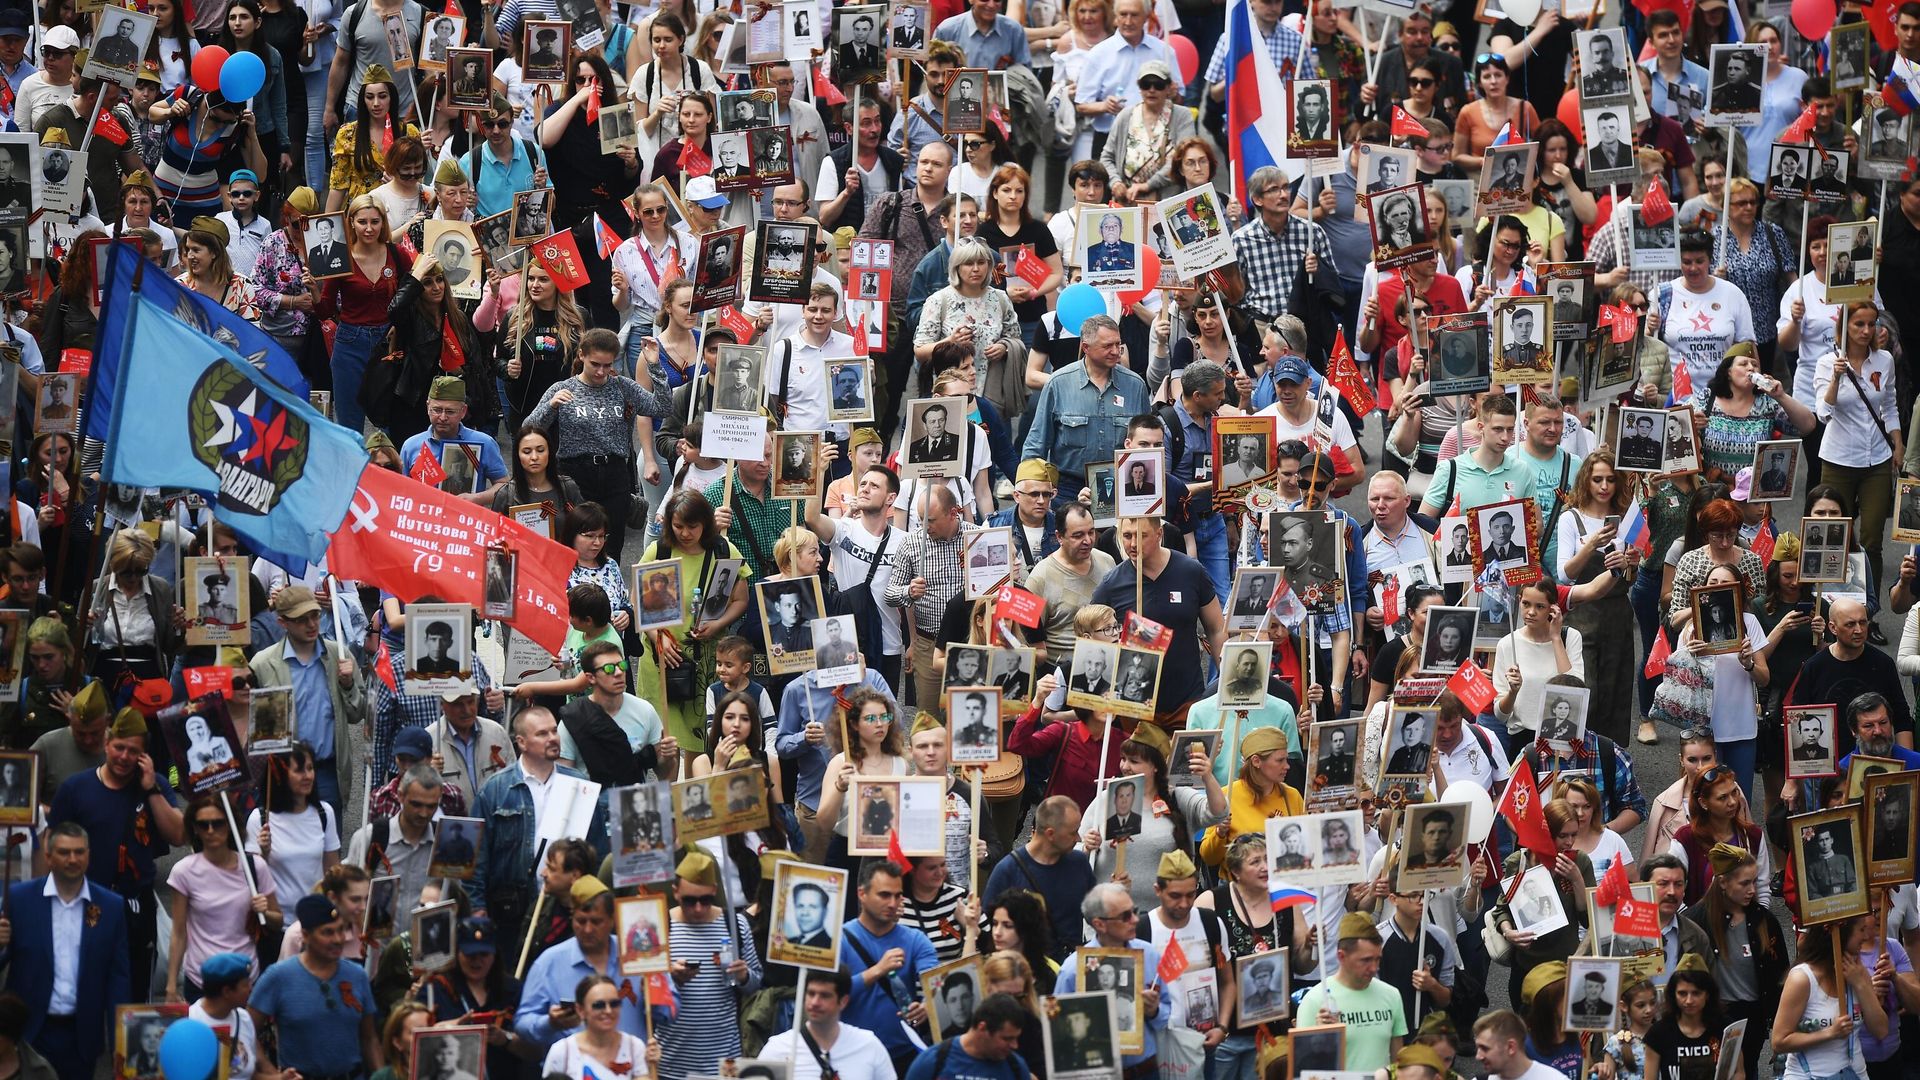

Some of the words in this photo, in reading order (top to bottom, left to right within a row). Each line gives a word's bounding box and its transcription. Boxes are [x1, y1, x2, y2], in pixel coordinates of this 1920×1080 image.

[1690, 343, 1716, 352] ПОЛК
[720, 424, 750, 432] МИХАИЛ
[390, 494, 414, 514] 150
[418, 503, 447, 520] СТР.
[397, 515, 468, 540] КУТУЗОВА
[445, 543, 474, 558] ДИВ.
[412, 548, 443, 574] 79
[1508, 572, 1538, 584] ГЕРОЯМ!
